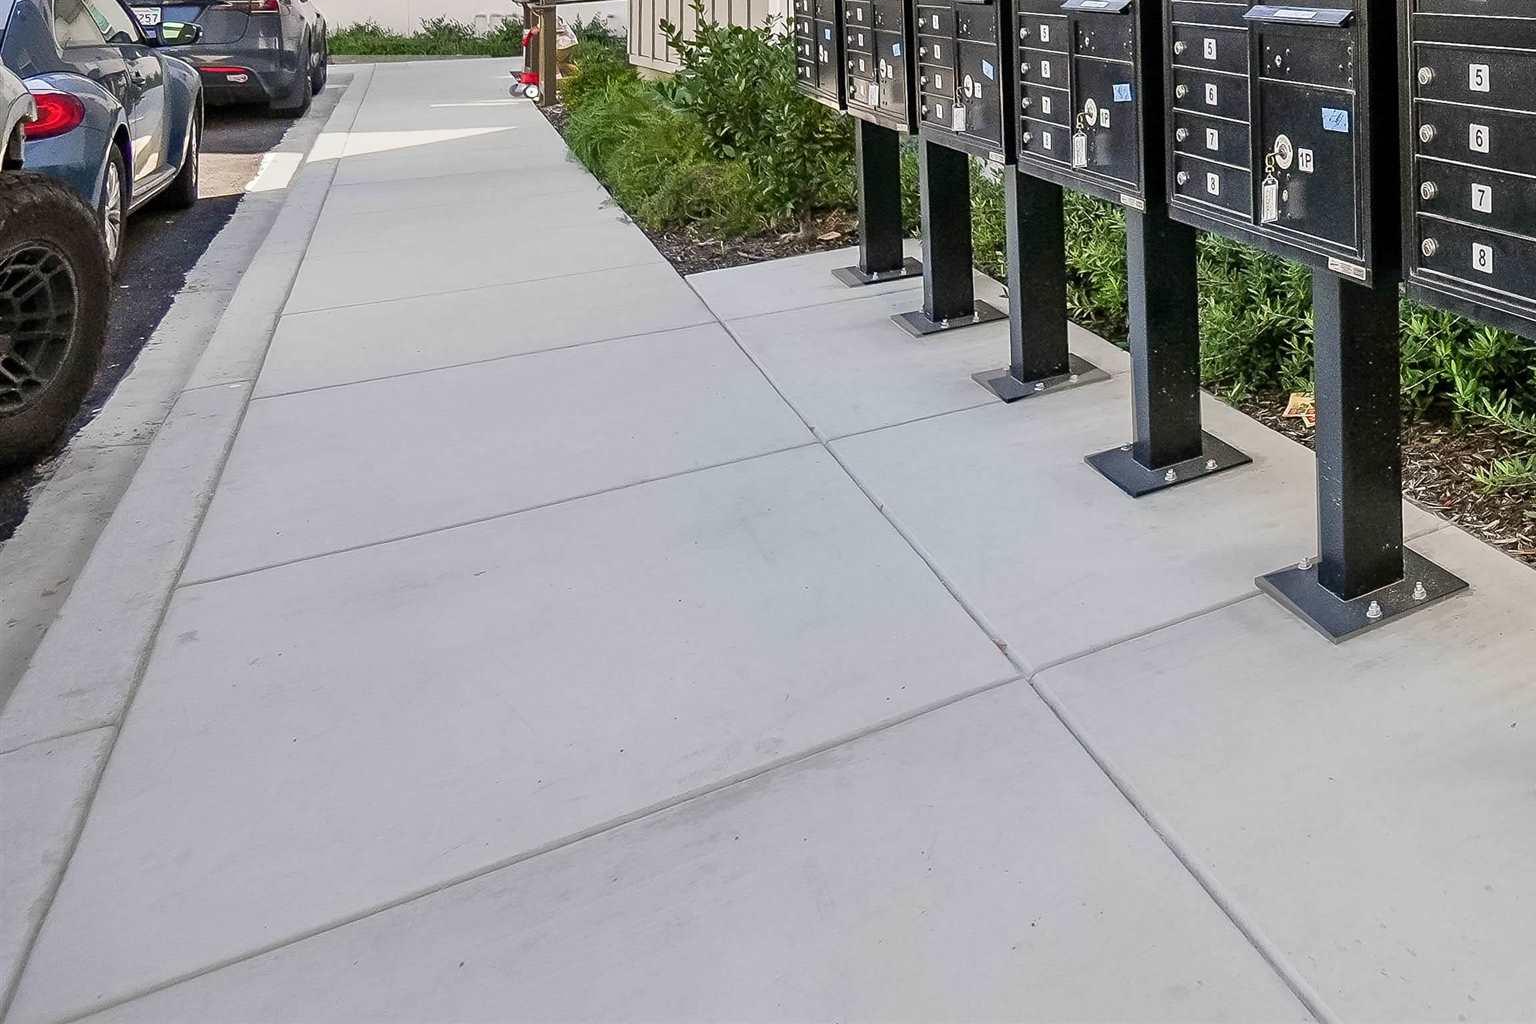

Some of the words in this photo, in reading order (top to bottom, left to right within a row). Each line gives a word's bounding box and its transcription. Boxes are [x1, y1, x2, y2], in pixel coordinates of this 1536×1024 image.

[1475, 68, 1483, 87] 5
[1475, 129, 1484, 148] 6
[1477, 188, 1486, 207] 7
[1478, 248, 1487, 267] 8
